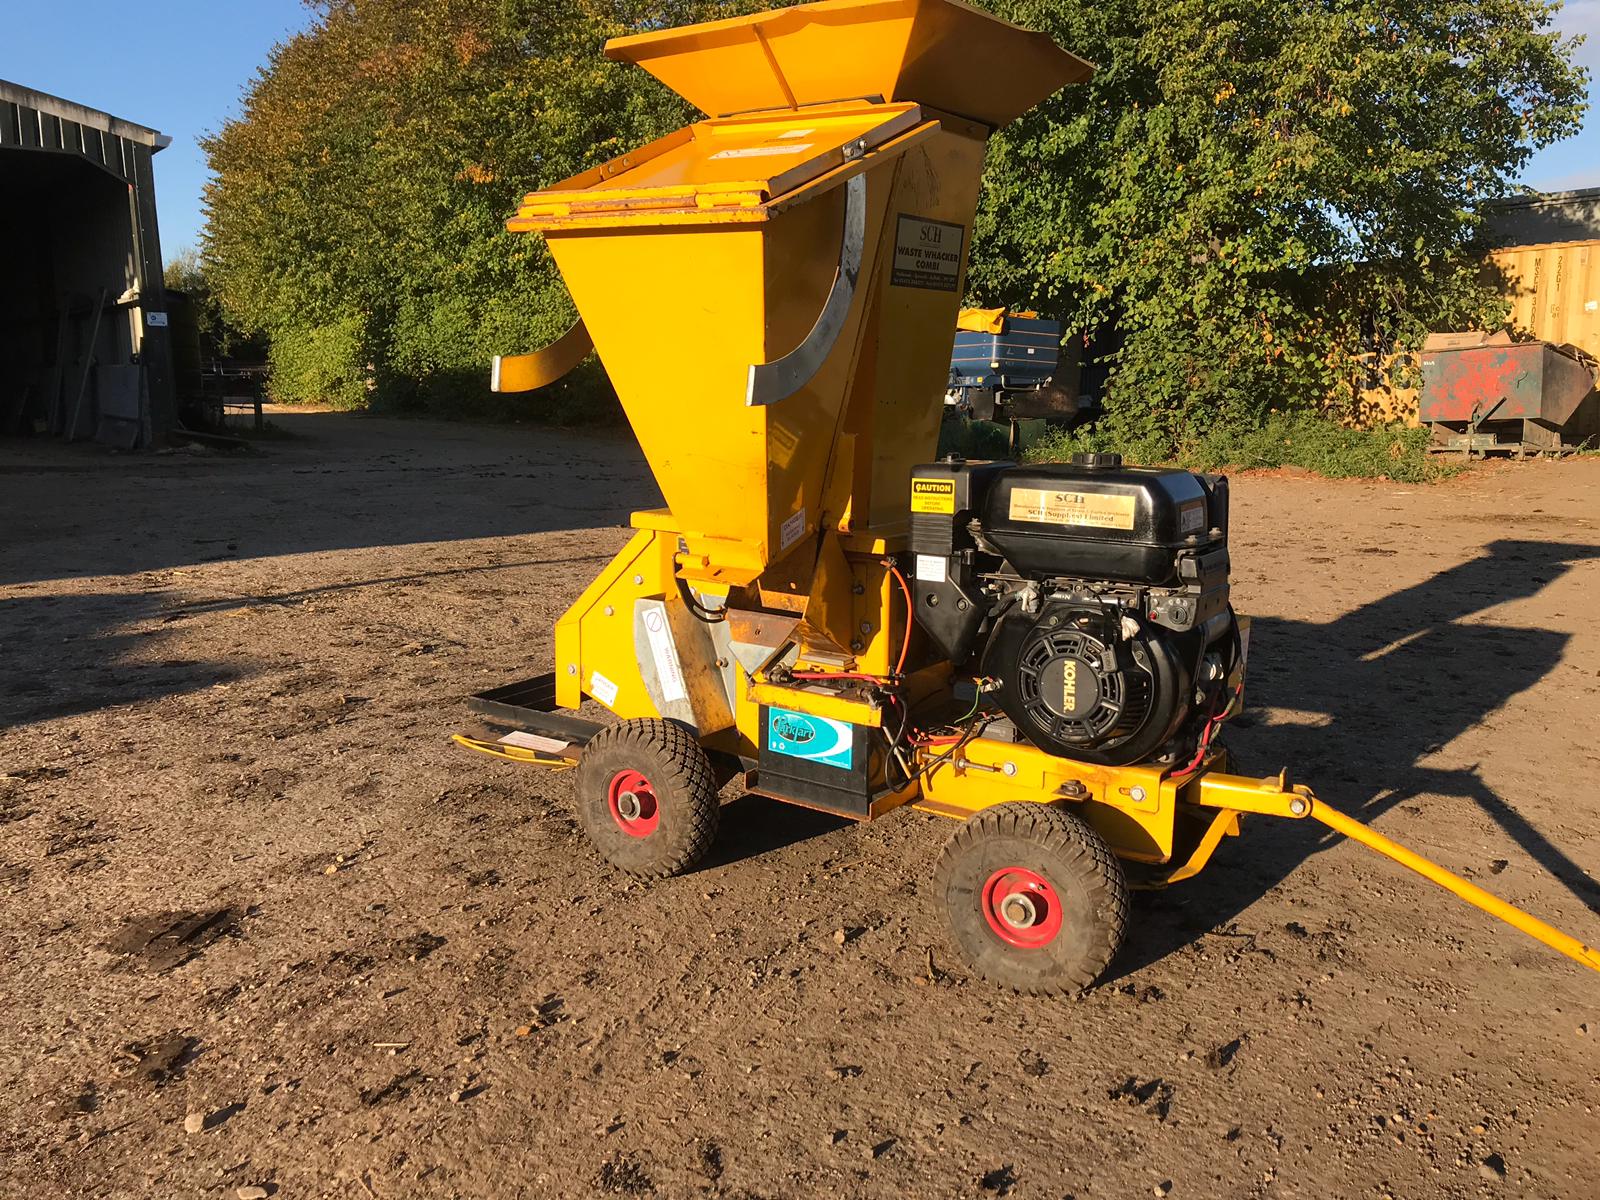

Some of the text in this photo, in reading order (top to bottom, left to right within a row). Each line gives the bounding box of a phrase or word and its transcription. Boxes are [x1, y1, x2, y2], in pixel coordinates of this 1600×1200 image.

[920, 226, 942, 243] SCH
[898, 246, 959, 263] WASTE WHACKER
[916, 260, 940, 271] COMBI
[915, 483, 951, 493] CAUTION
[1055, 493, 1085, 504] SCH
[1063, 660, 1076, 713] KOHLER
